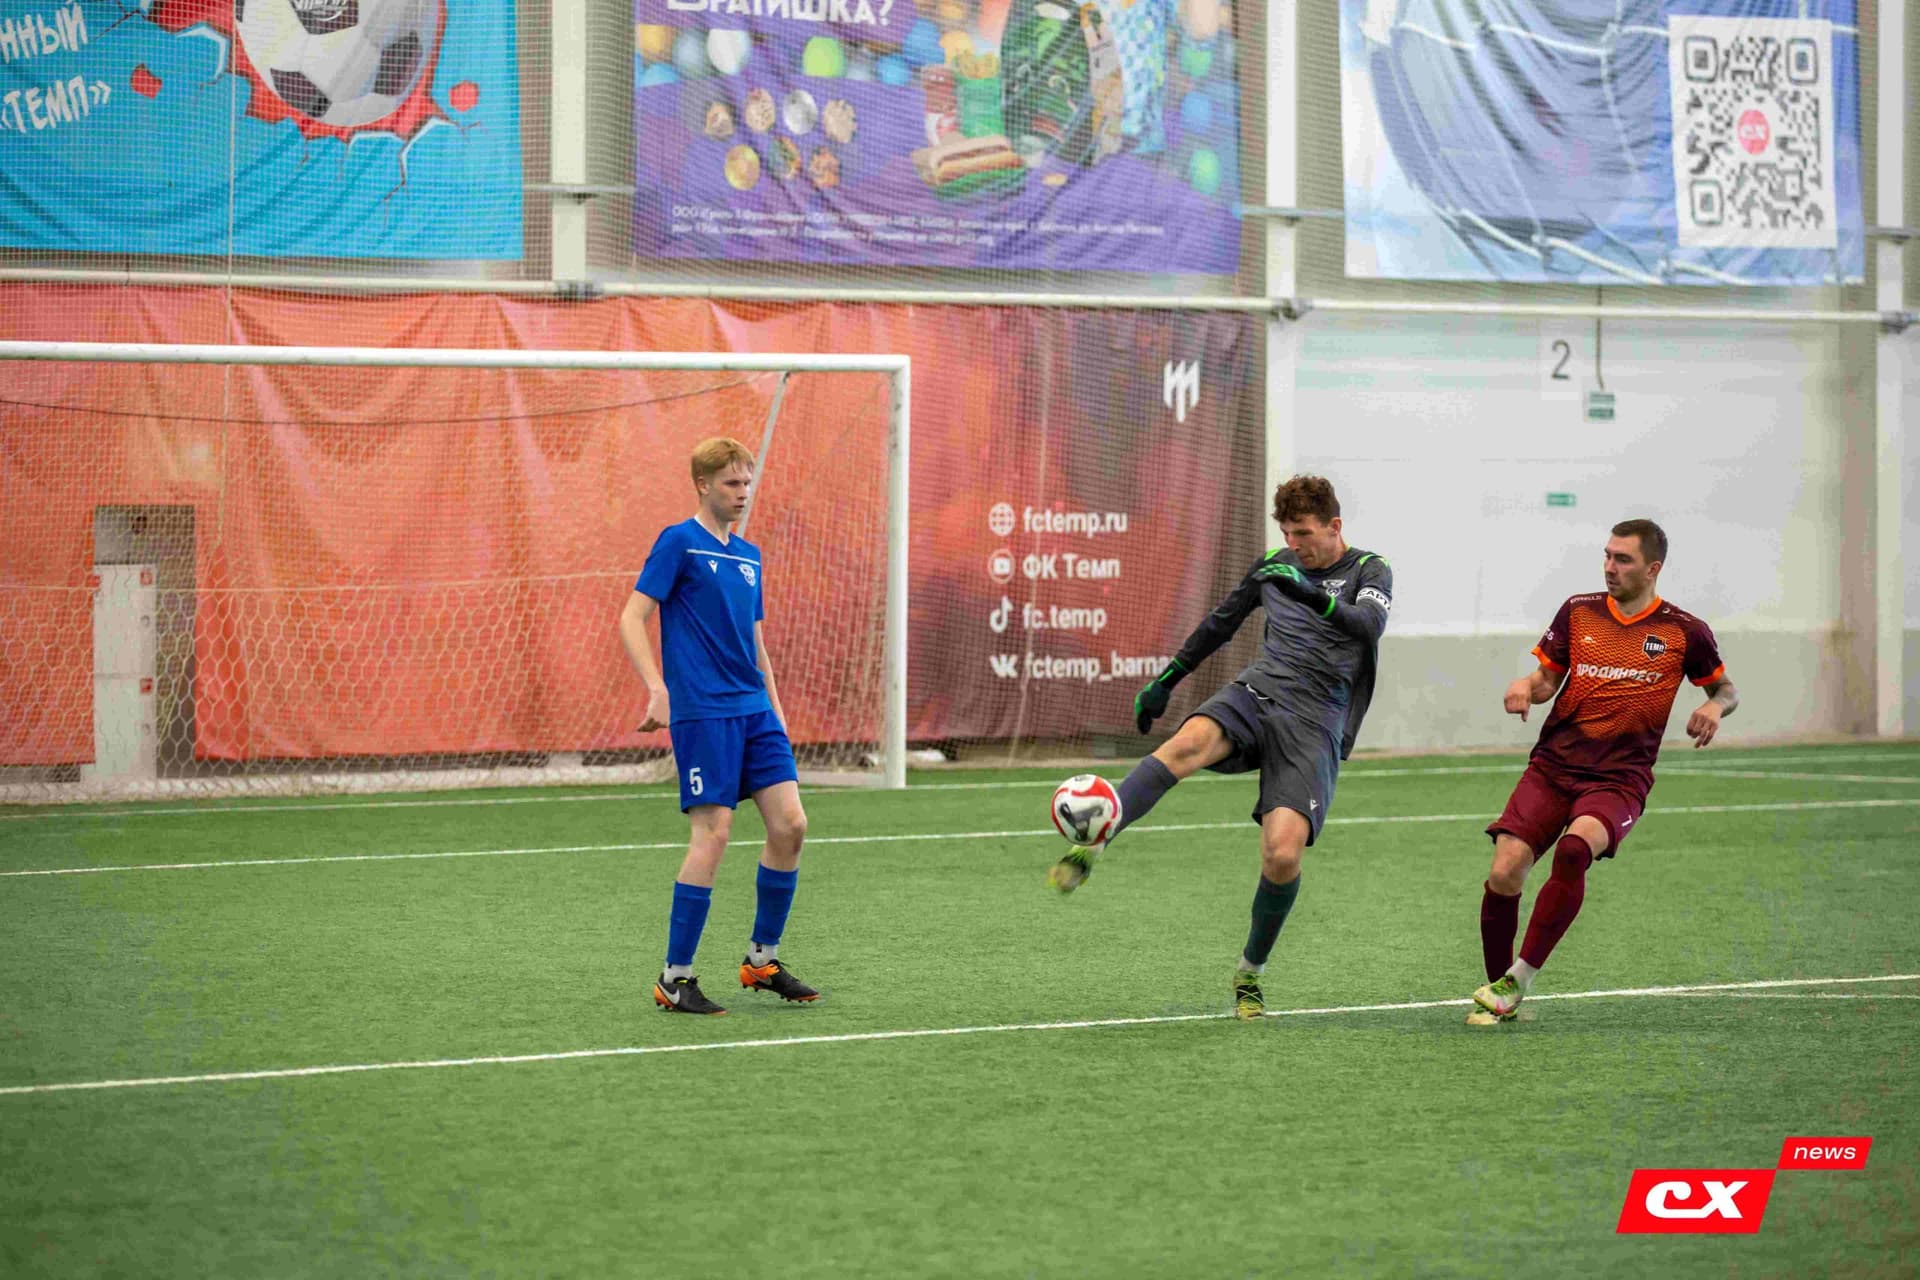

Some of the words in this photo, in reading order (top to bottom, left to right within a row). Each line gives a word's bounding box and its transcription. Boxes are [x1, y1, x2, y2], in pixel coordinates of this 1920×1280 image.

[1551, 339, 1571, 380] 2
[1023, 506, 1127, 538] fctemp.ru
[1022, 554, 1057, 579] ФК
[1063, 554, 1121, 579] Темп
[1022, 602, 1107, 634] fc.temp
[689, 767, 704, 796] 5
